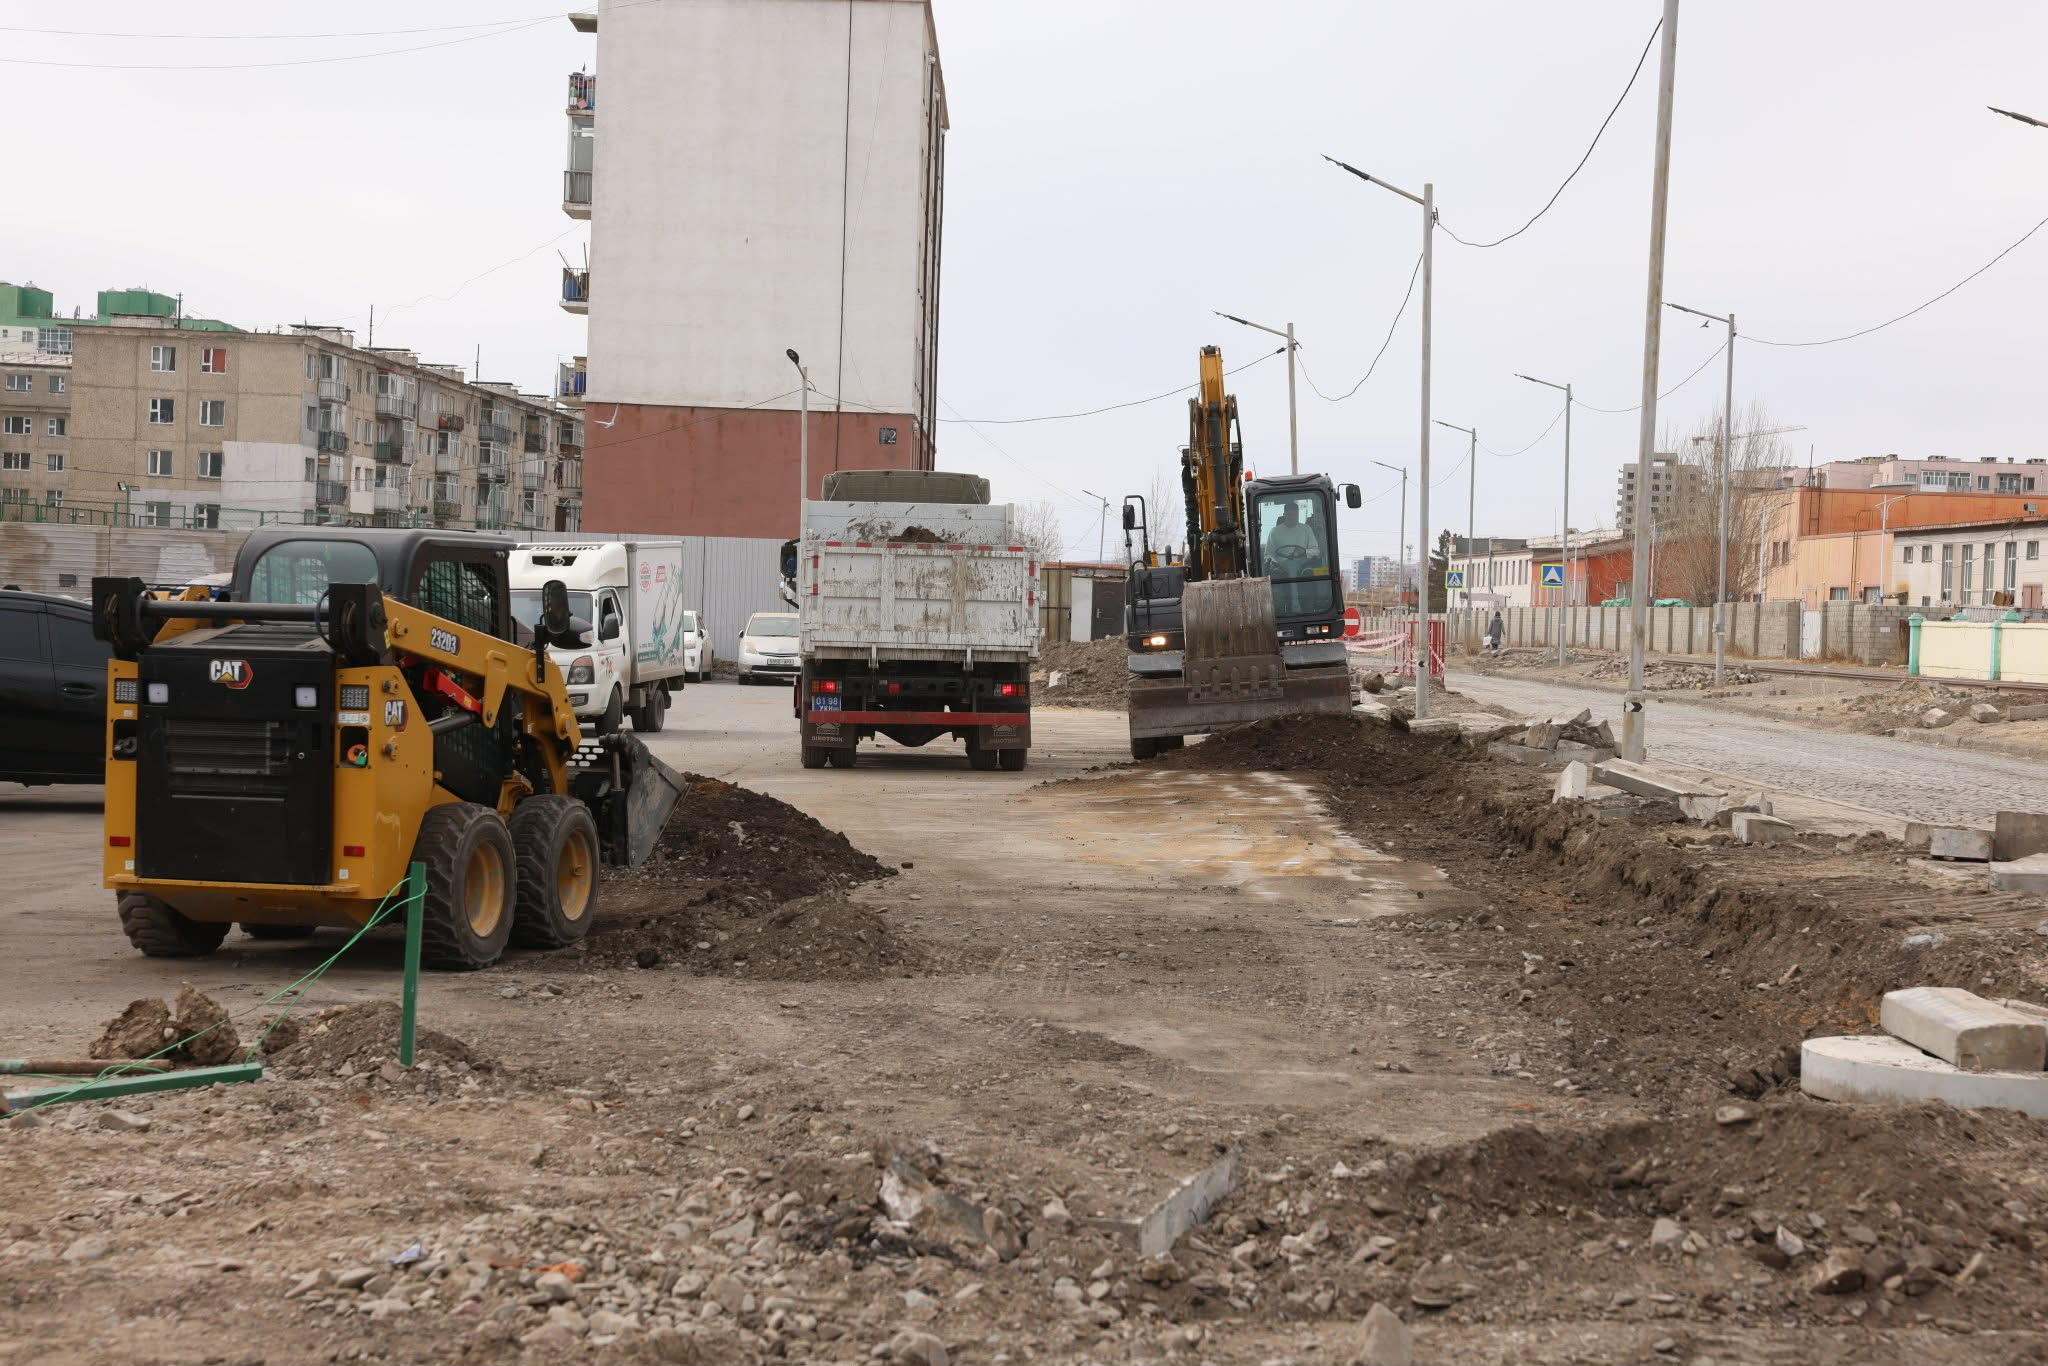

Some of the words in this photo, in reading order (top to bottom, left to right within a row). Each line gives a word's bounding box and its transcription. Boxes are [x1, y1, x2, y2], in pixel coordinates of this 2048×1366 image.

[431, 628, 457, 653] 232D3
[210, 661, 243, 682] CAT
[385, 701, 404, 726] CAT
